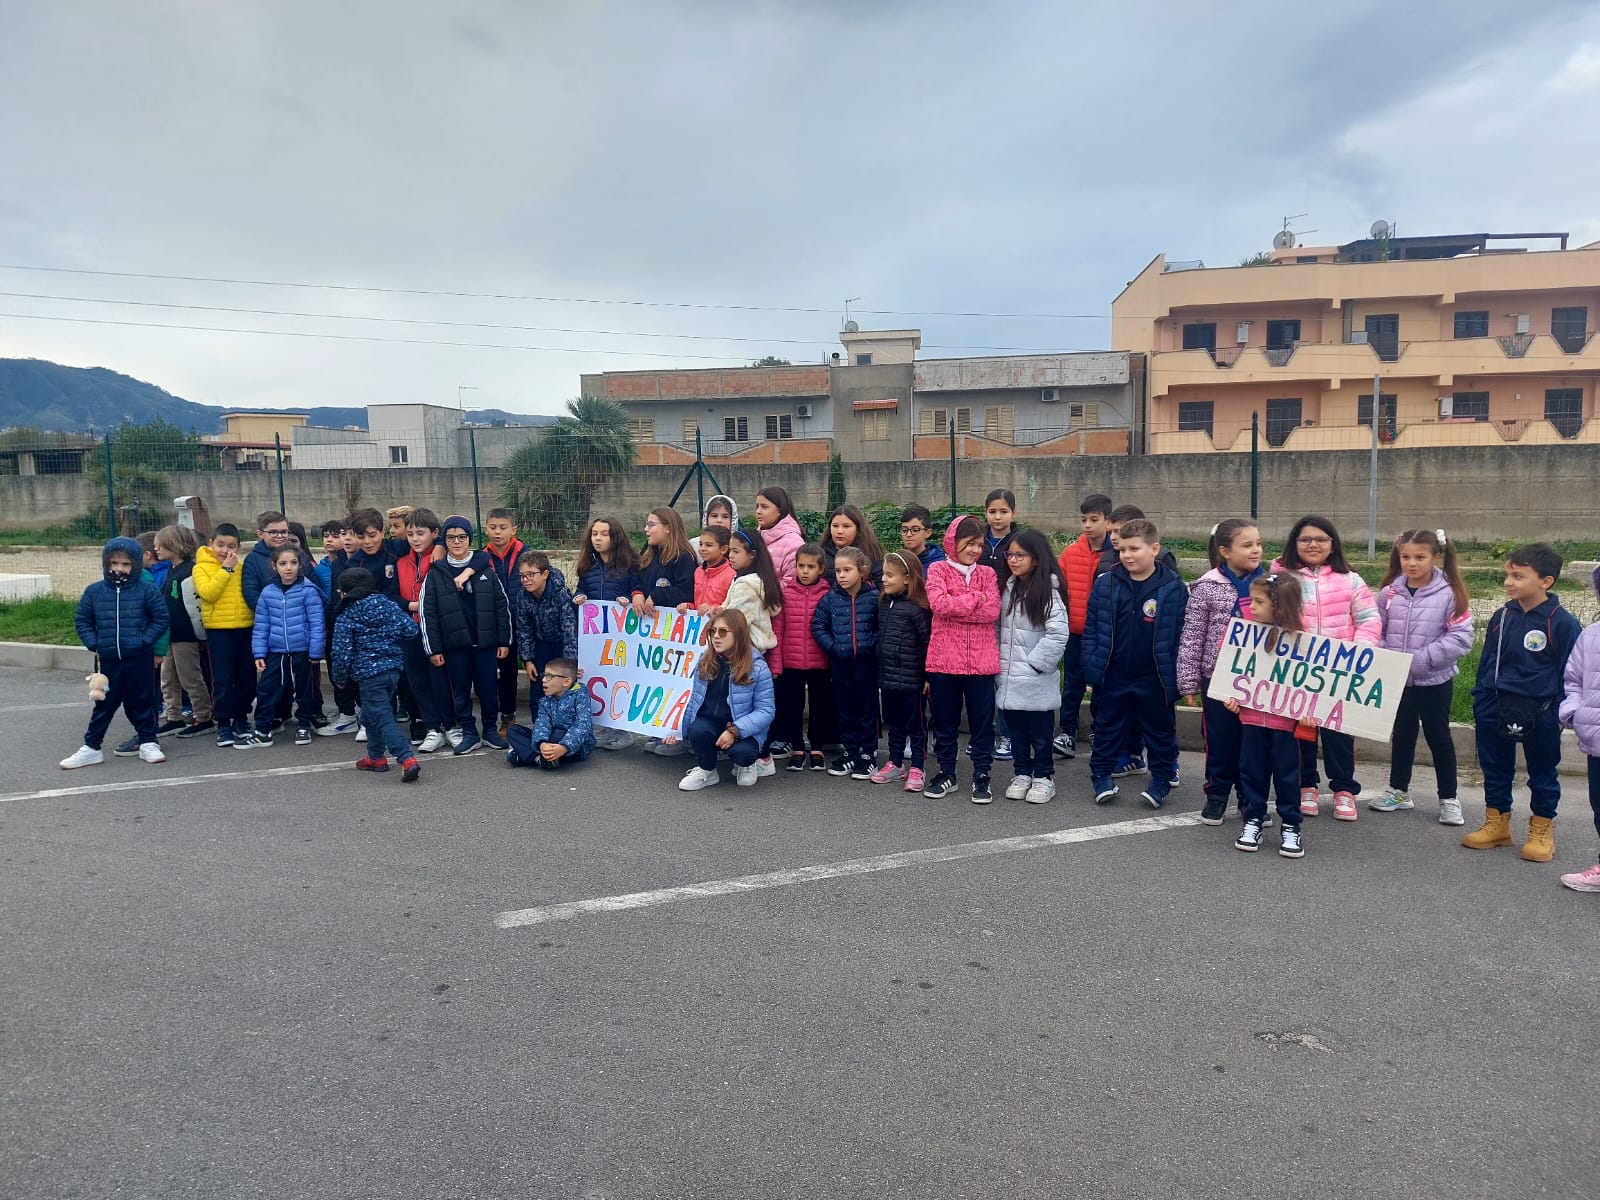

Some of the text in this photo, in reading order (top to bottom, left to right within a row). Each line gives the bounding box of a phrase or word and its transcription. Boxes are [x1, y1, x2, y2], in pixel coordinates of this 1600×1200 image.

[600, 639, 704, 679] LA NOSTR
[1230, 647, 1383, 709] LA NOSTRA
[586, 676, 691, 731] SCUOLA
[1231, 675, 1344, 731] SCUOLA
